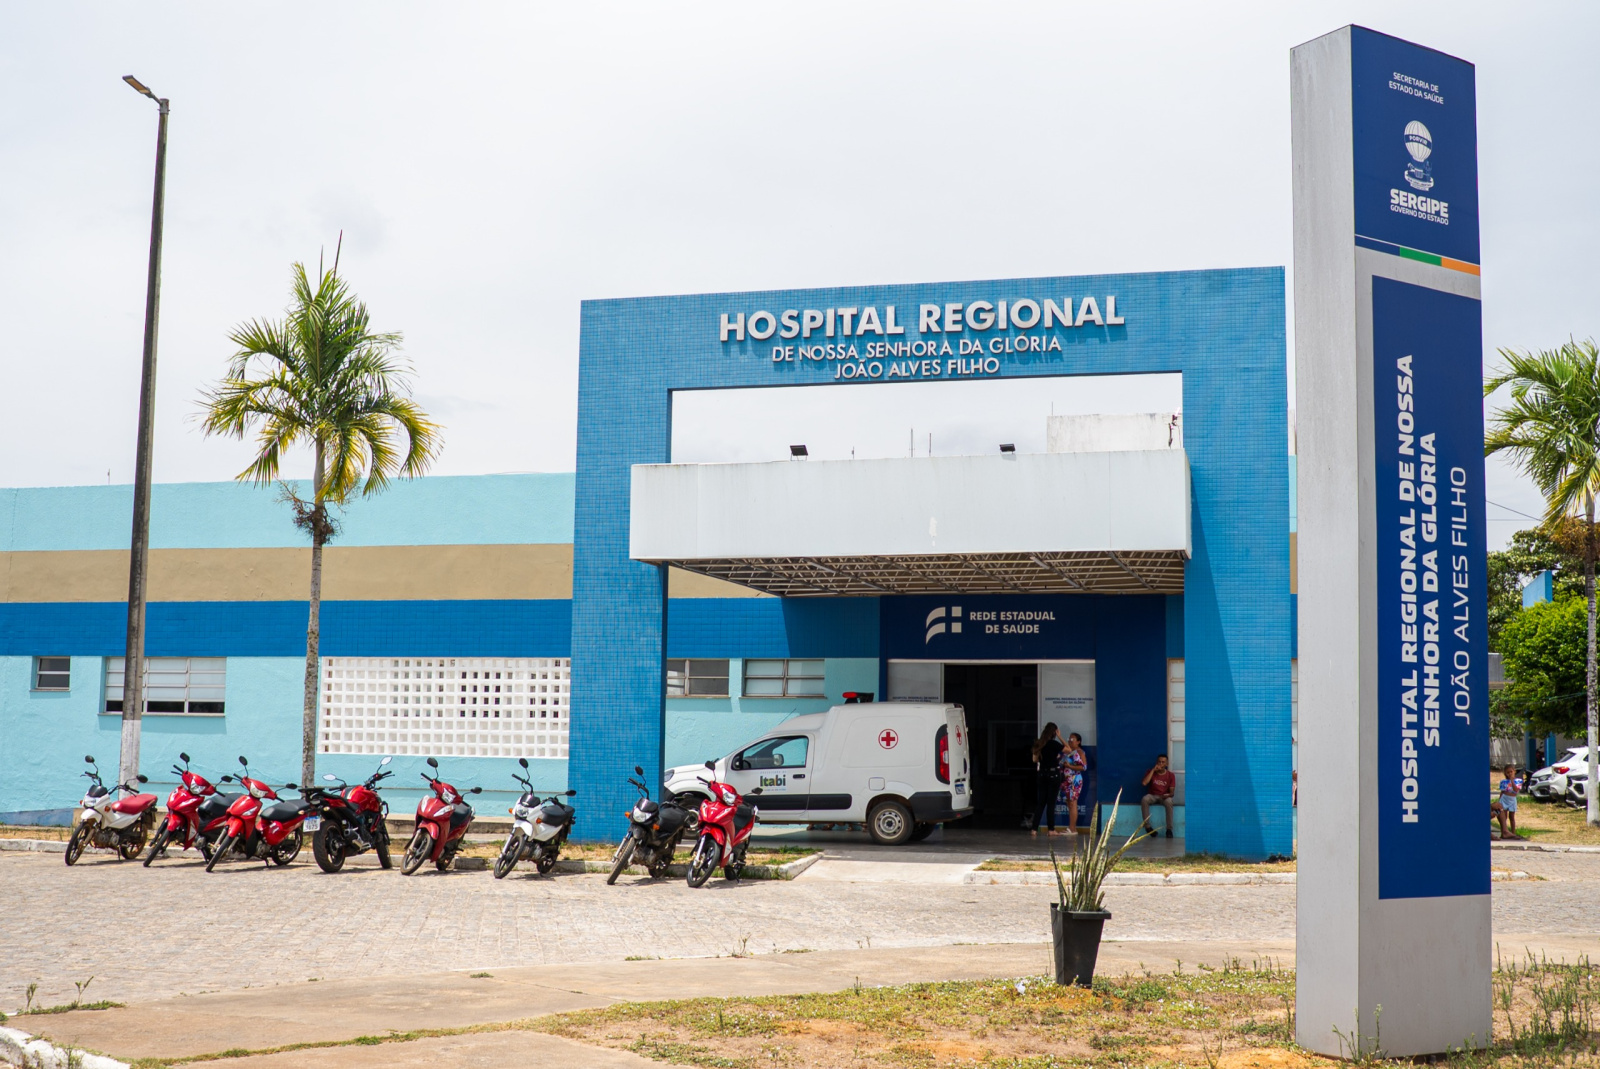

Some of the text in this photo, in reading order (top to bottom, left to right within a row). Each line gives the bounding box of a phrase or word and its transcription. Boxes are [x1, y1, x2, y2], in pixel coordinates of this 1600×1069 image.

[1388, 80, 1444, 105] ESTADO DA SAÚDE
[1393, 71, 1439, 93] SECRETARIA DE
[1390, 188, 1449, 218] SERGIPE
[1390, 204, 1449, 226] GOVERNO DO ESTADO
[719, 295, 1126, 342] HOSPITAL REGIONAL
[772, 332, 1062, 362] DE NOSSA SENHORA DA GLÓRIA
[834, 357, 1000, 380] JOÃO ALVES FILHO
[1397, 354, 1419, 823] HOSPITAL REGIONAL DE NOSSA
[1416, 432, 1440, 747] SENHORA DA GLÓRIA
[1450, 466, 1471, 725] JOÃO ALVES FILHO
[969, 611, 1056, 621] REDE ESTADUAL
[985, 621, 1040, 634] DE SAÚDE
[759, 774, 787, 787] Itabi
